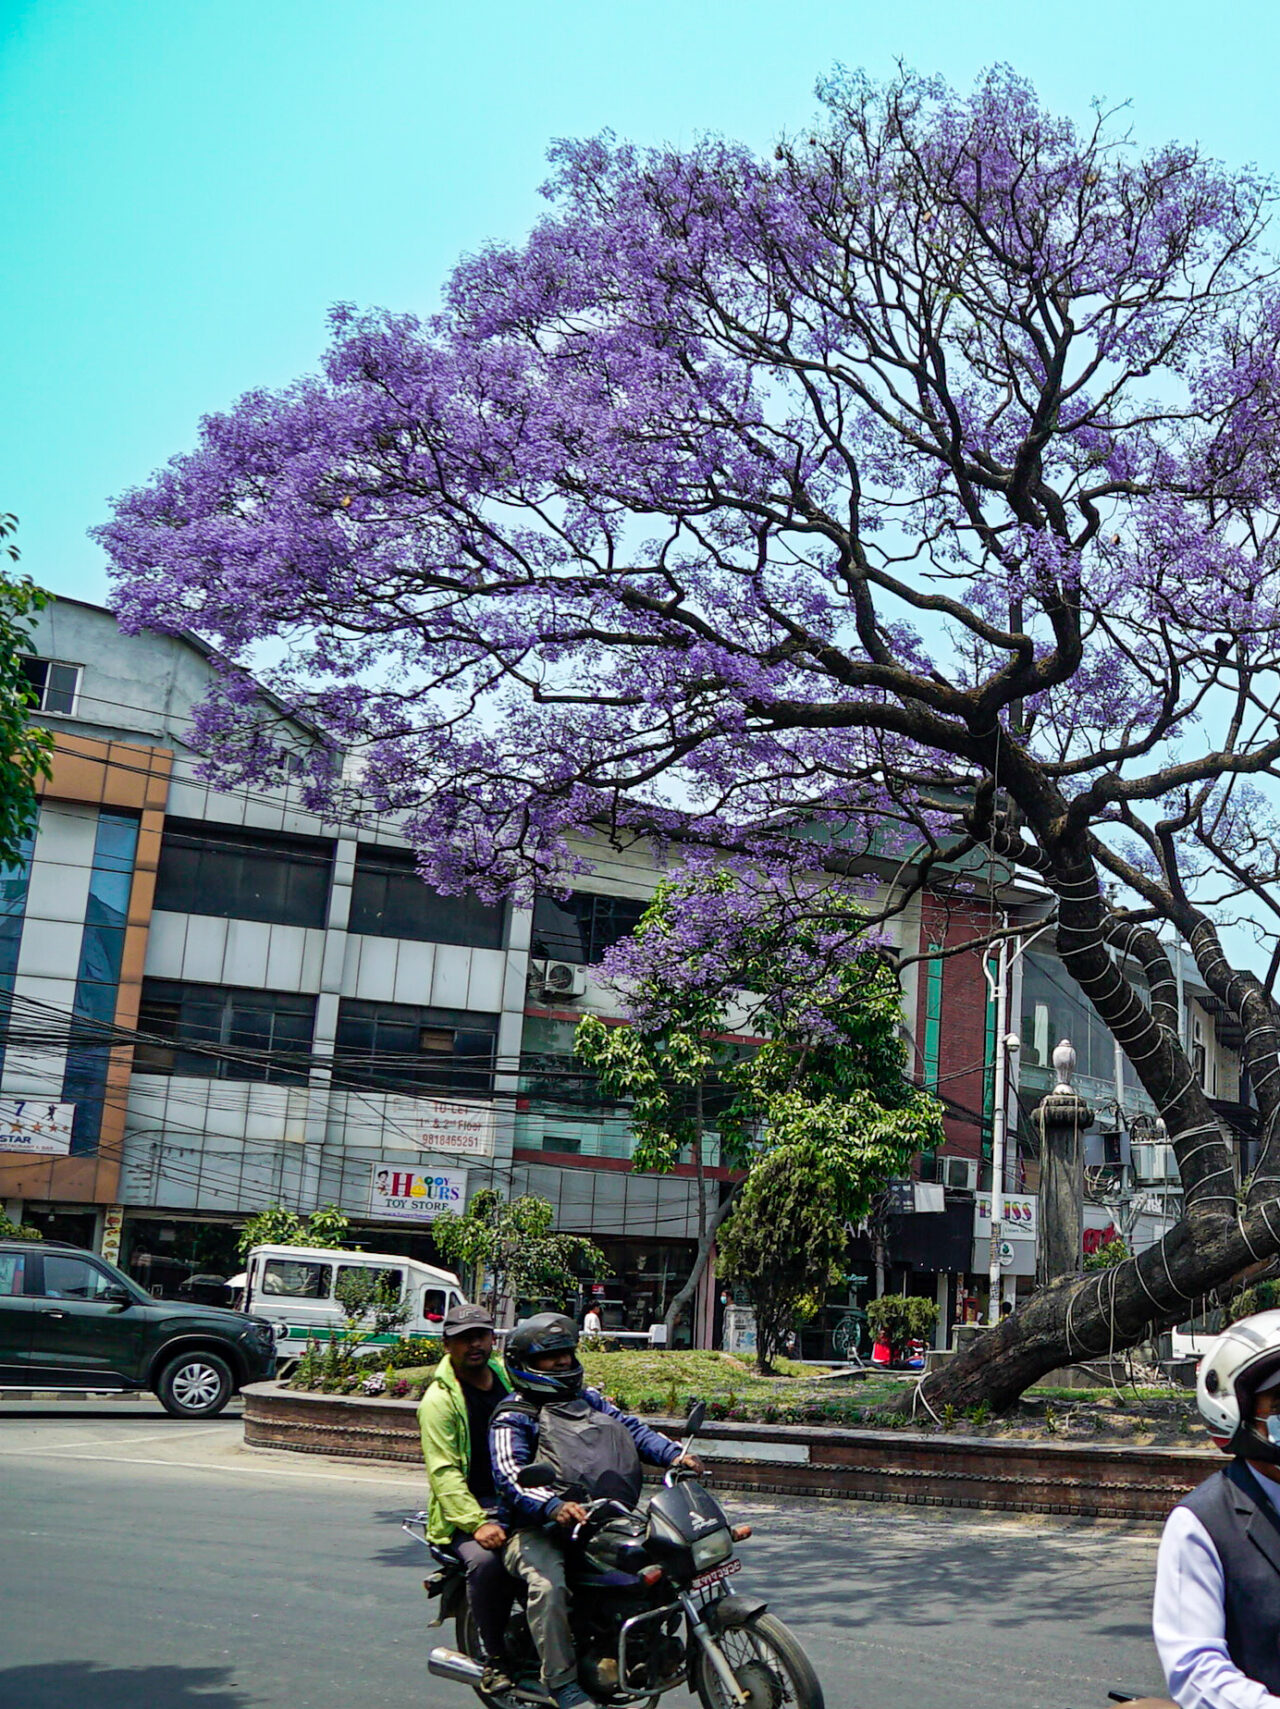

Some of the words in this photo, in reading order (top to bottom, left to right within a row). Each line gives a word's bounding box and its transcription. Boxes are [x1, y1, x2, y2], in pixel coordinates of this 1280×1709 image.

[0, 1134, 32, 1144] STAR
[385, 1198, 408, 1209] TOY
[411, 1200, 449, 1211] STORE
[979, 1199, 1032, 1221] BISS
